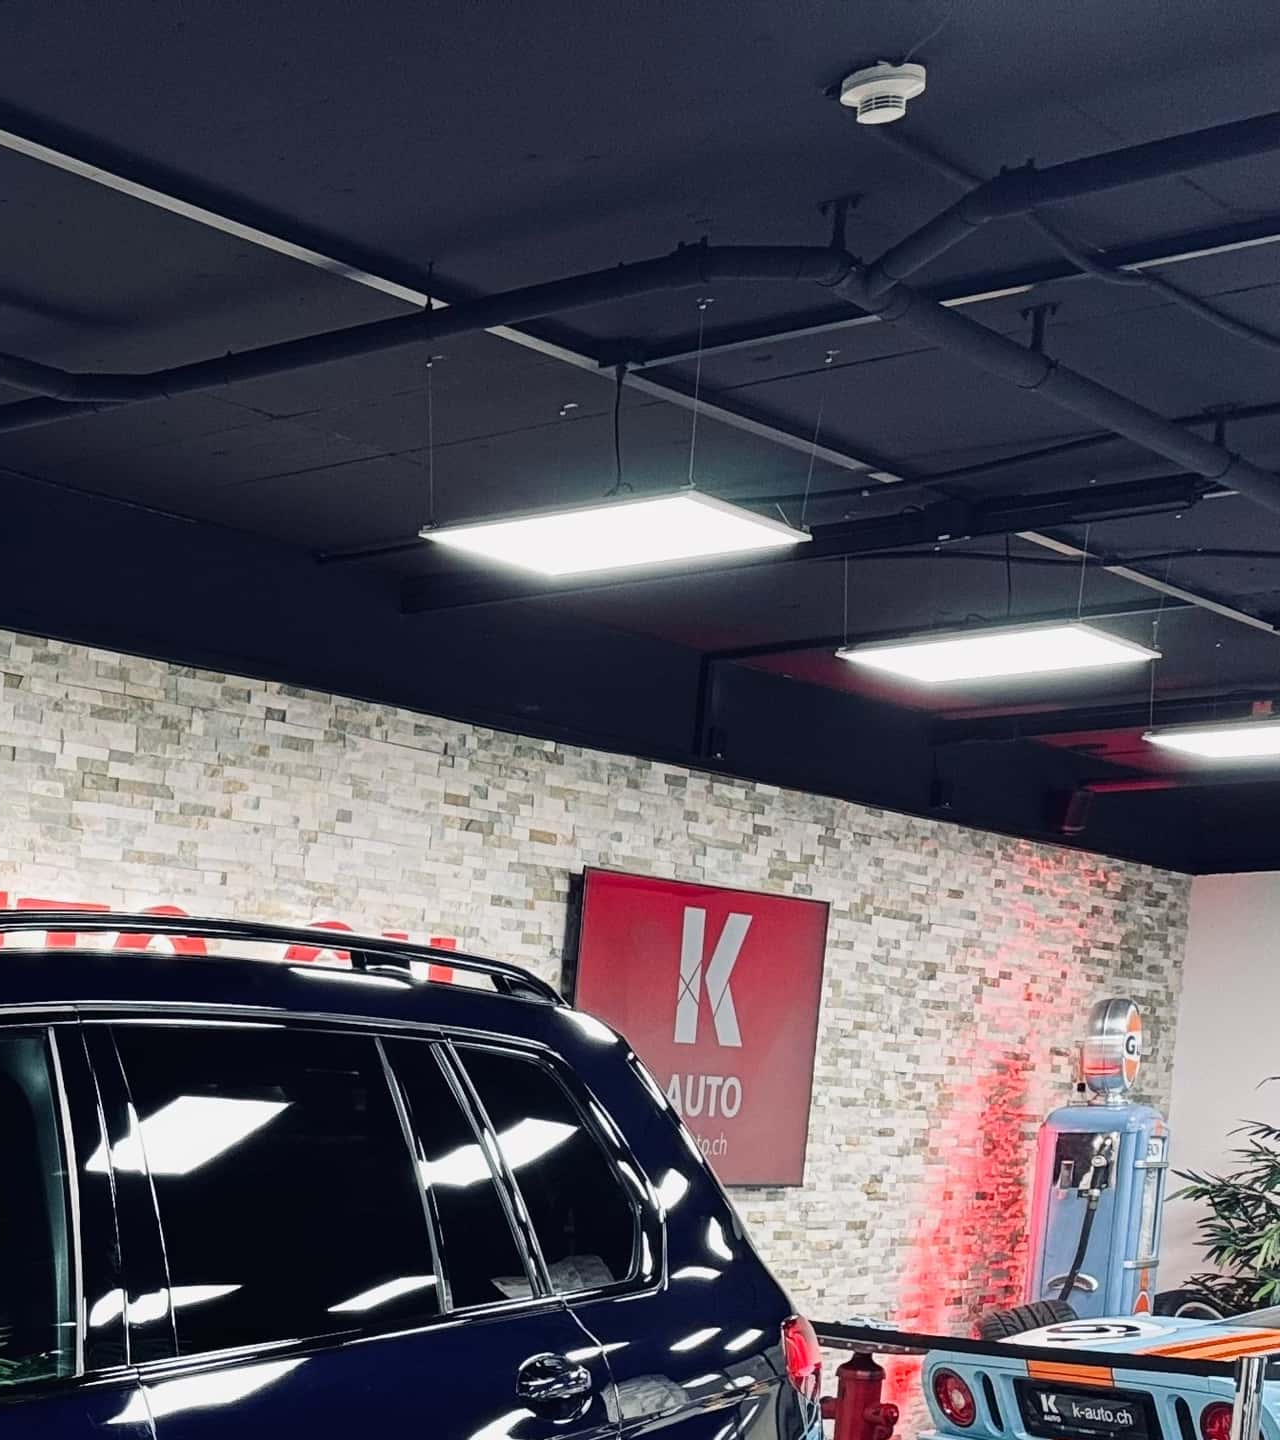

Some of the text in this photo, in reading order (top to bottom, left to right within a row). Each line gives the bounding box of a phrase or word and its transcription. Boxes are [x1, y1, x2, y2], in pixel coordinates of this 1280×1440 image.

[674, 906, 753, 1048] K
[666, 1074, 742, 1118] AUTO
[1040, 1393, 1059, 1414] K
[1071, 1401, 1134, 1425] k-auto.ch
